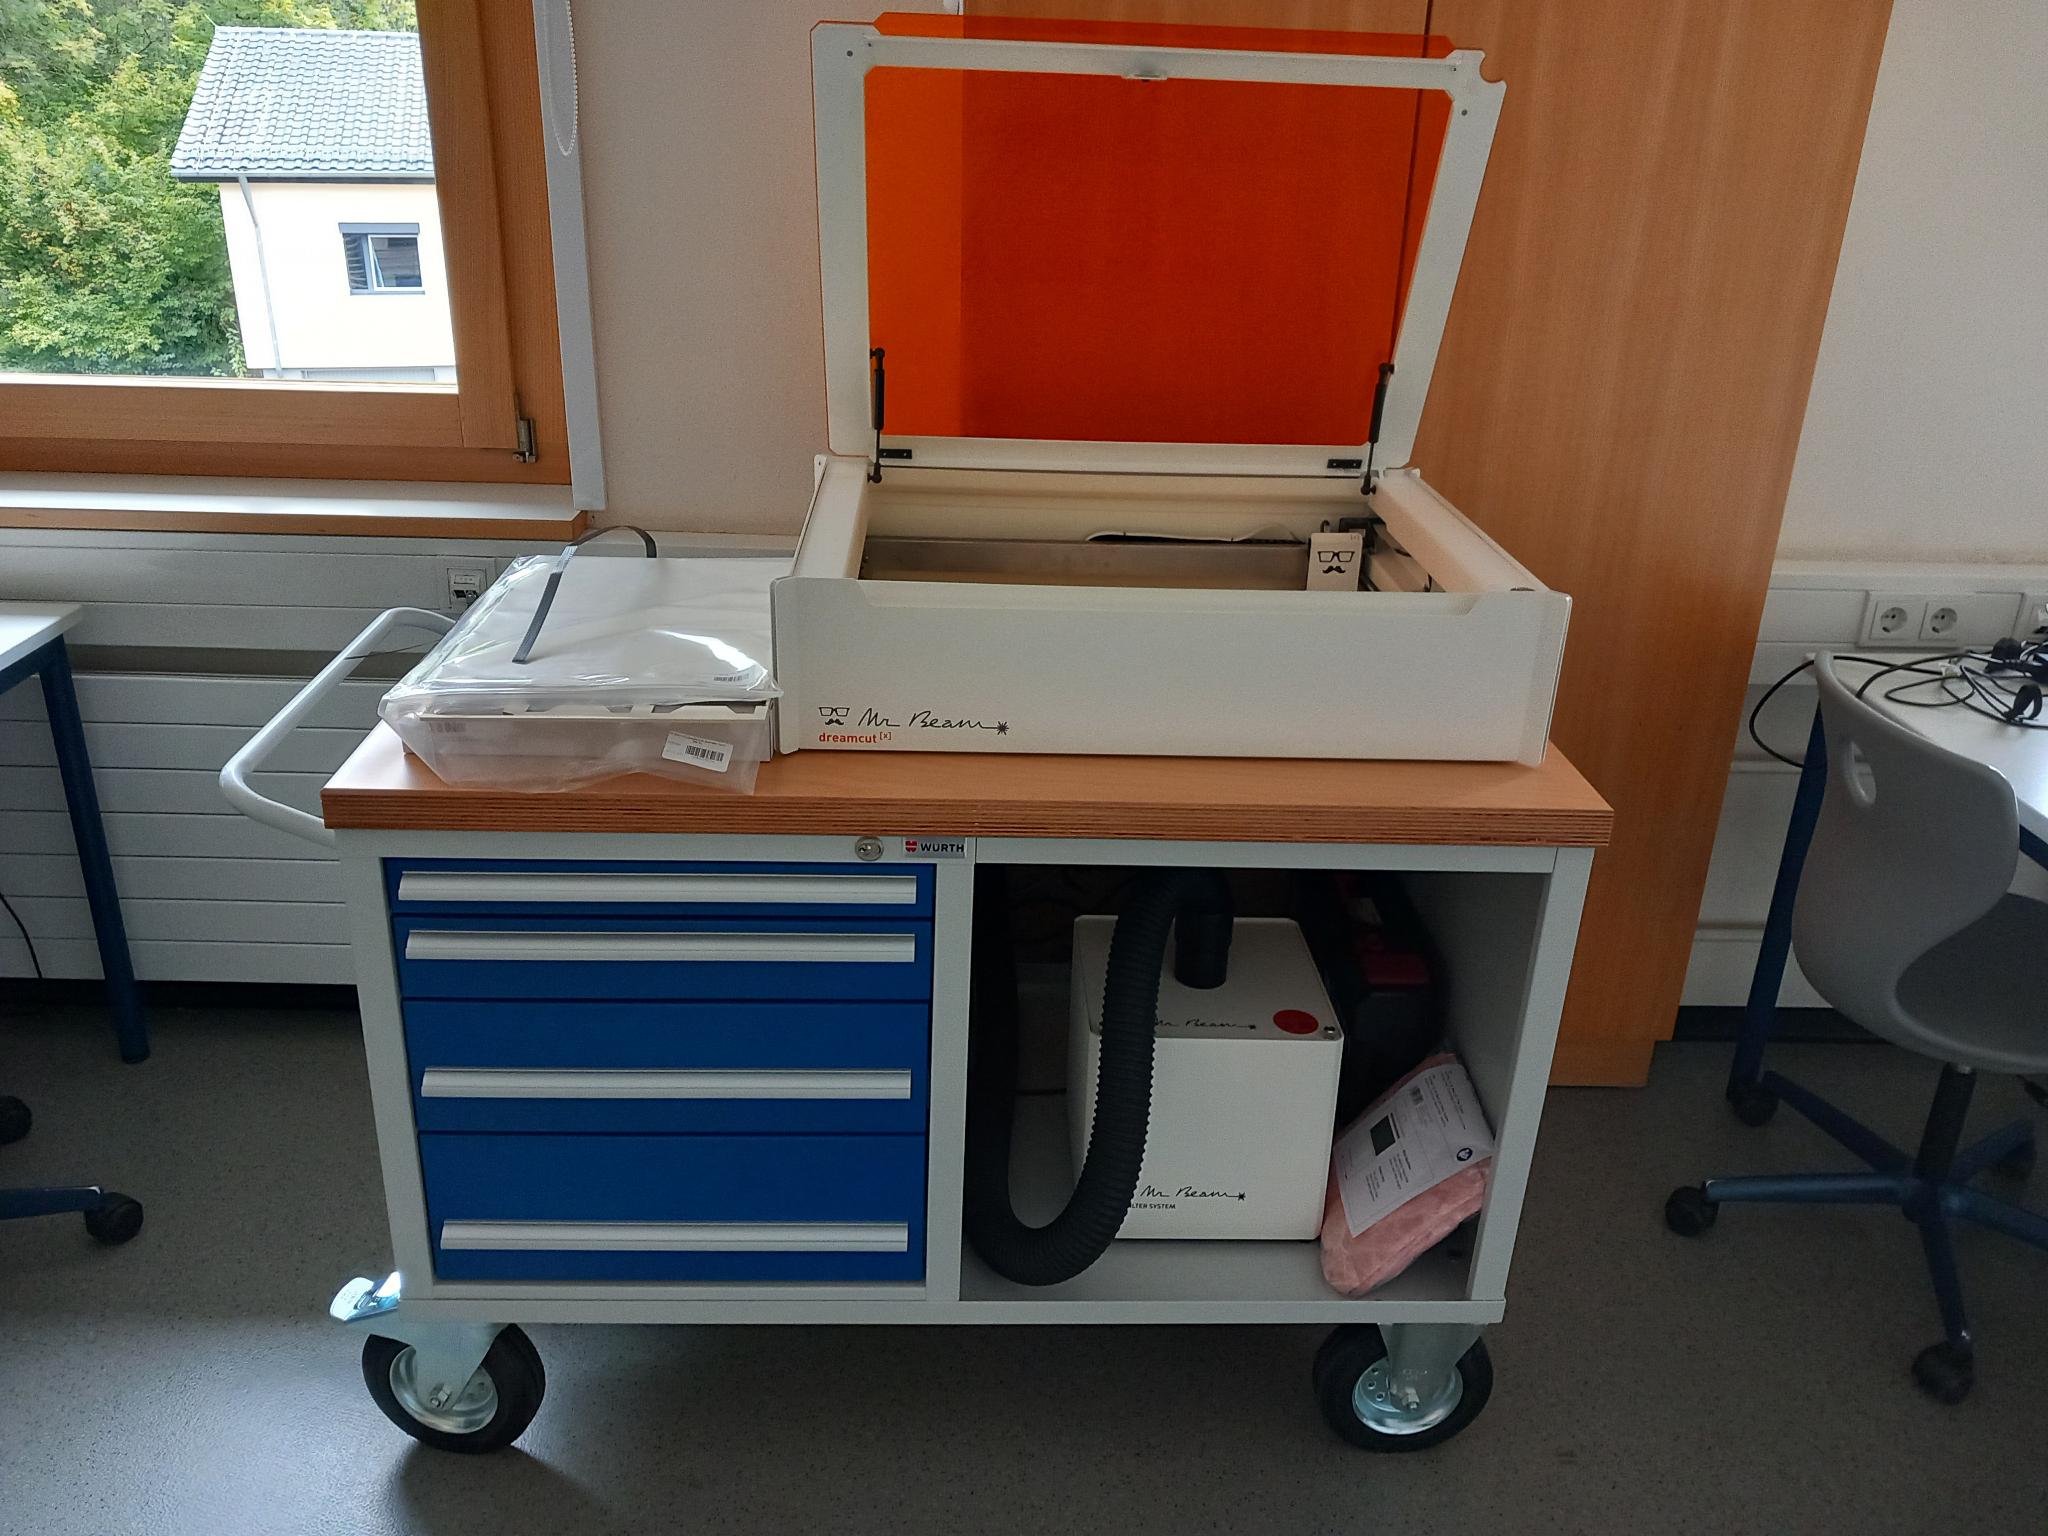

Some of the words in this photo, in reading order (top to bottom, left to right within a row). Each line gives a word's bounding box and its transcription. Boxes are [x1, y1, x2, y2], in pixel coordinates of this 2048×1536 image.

[858, 707, 900, 727] Mr
[909, 710, 998, 728] Beam
[818, 732, 877, 743] dreamcut
[1140, 1185, 1170, 1198] Mr
[1175, 1185, 1239, 1198] Beam
